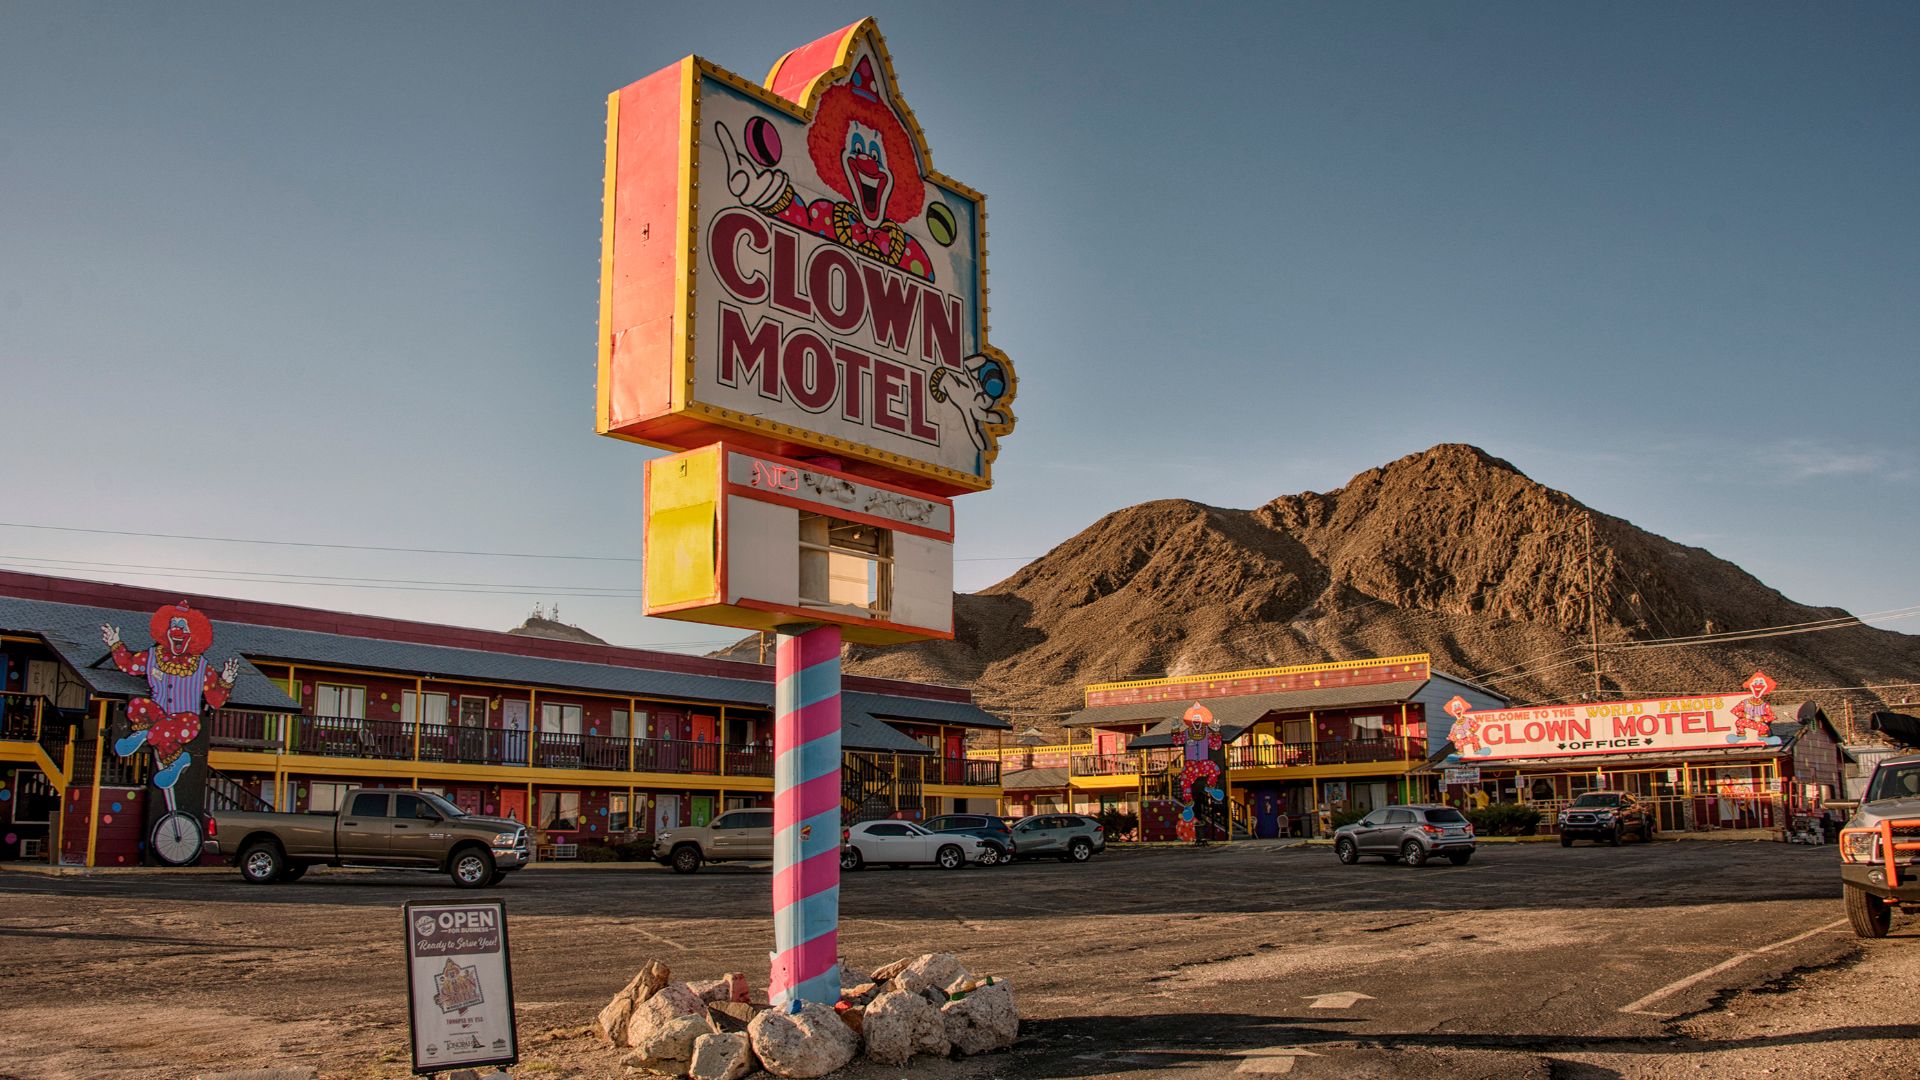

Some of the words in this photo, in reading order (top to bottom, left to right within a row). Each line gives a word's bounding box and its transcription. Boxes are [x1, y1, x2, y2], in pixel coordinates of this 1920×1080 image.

[708, 209, 964, 370] CLOWN
[718, 303, 939, 446] MOTEL
[751, 460, 800, 491] NO
[1474, 711, 1531, 724] WELCOME
[1533, 709, 1550, 720] TO
[1552, 707, 1576, 718] THE
[1585, 702, 1644, 719] WORLD
[1659, 697, 1725, 714] FAMOUS
[1482, 718, 1592, 746] CLOWN
[1613, 710, 1732, 739] MOTEL
[1569, 738, 1641, 750] OFFICE
[438, 911, 494, 928] OPEN
[417, 939, 447, 952] Ready
[447, 940, 455, 948] to
[455, 937, 478, 950] Serve
[478, 936, 497, 950] You!
